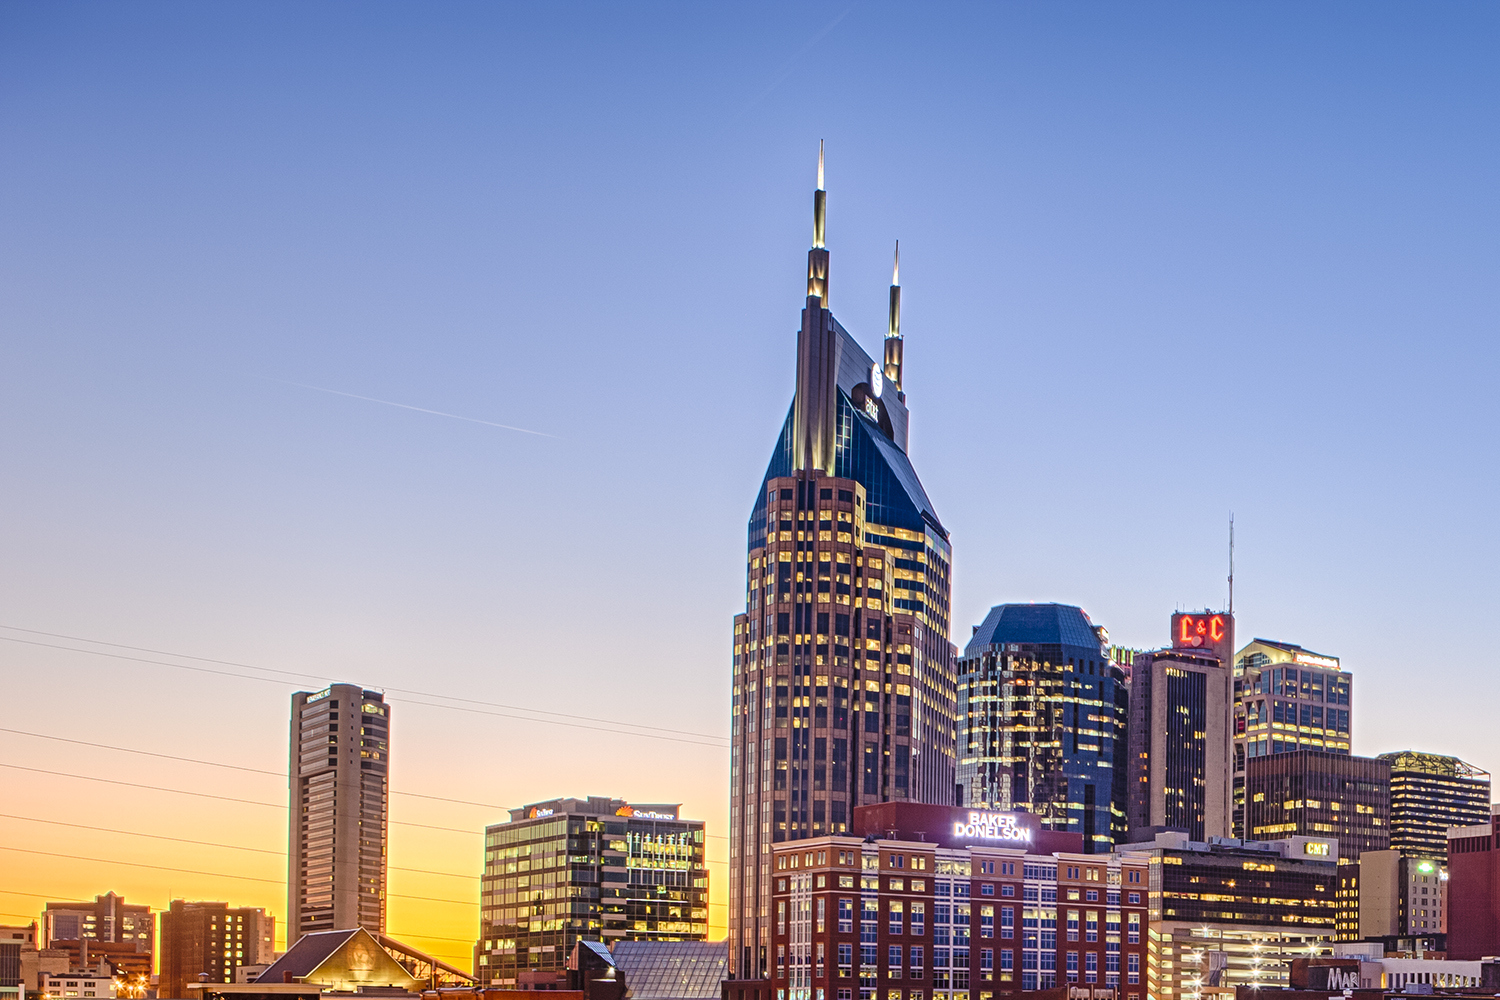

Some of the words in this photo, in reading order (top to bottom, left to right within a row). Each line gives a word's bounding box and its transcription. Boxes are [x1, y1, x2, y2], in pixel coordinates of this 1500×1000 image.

[969, 812, 1016, 828] BAKER
[954, 822, 1031, 841] DONELSON
[1306, 842, 1329, 856] CMT
